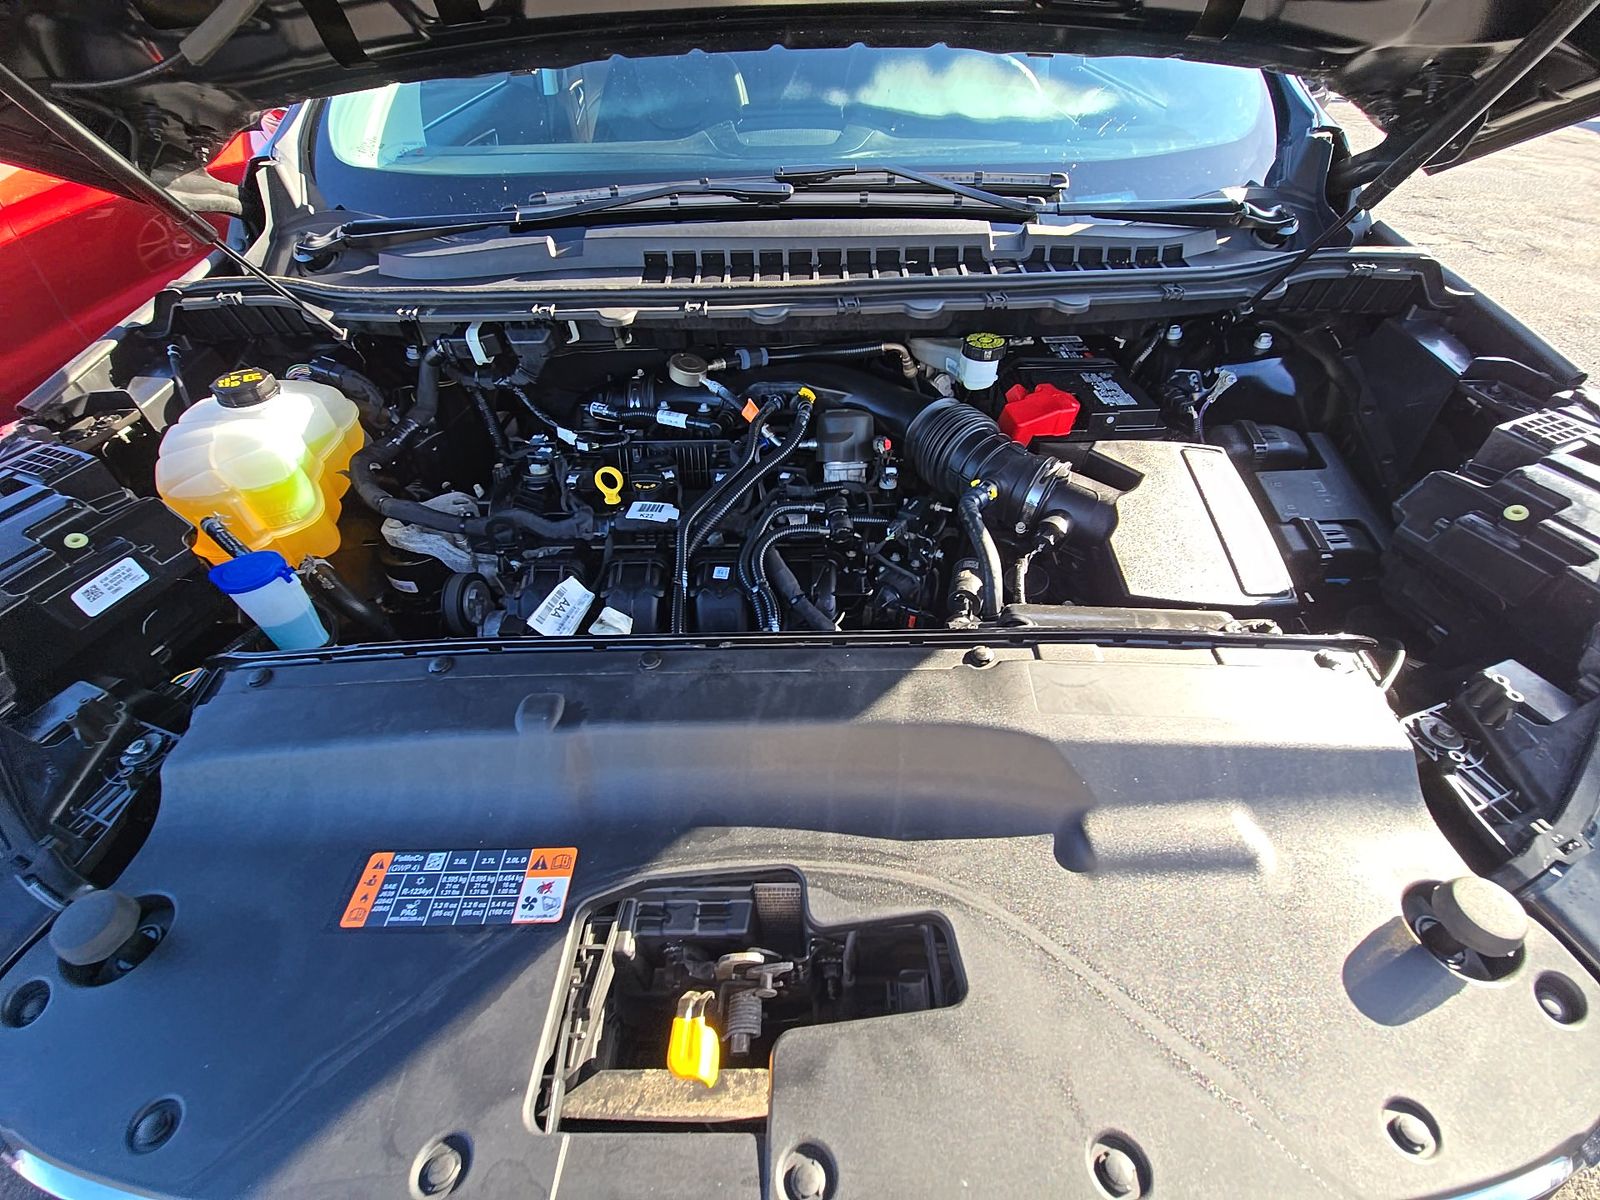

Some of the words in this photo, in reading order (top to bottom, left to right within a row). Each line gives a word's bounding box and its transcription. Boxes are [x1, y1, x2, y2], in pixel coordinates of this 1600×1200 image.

[550, 596, 571, 619] AAA
[388, 864, 409, 873] (GWP
[411, 864, 421, 873] 4)
[459, 876, 468, 884] kg
[488, 875, 496, 884] kg
[516, 874, 524, 883] kg
[400, 888, 434, 896] R-1234yf
